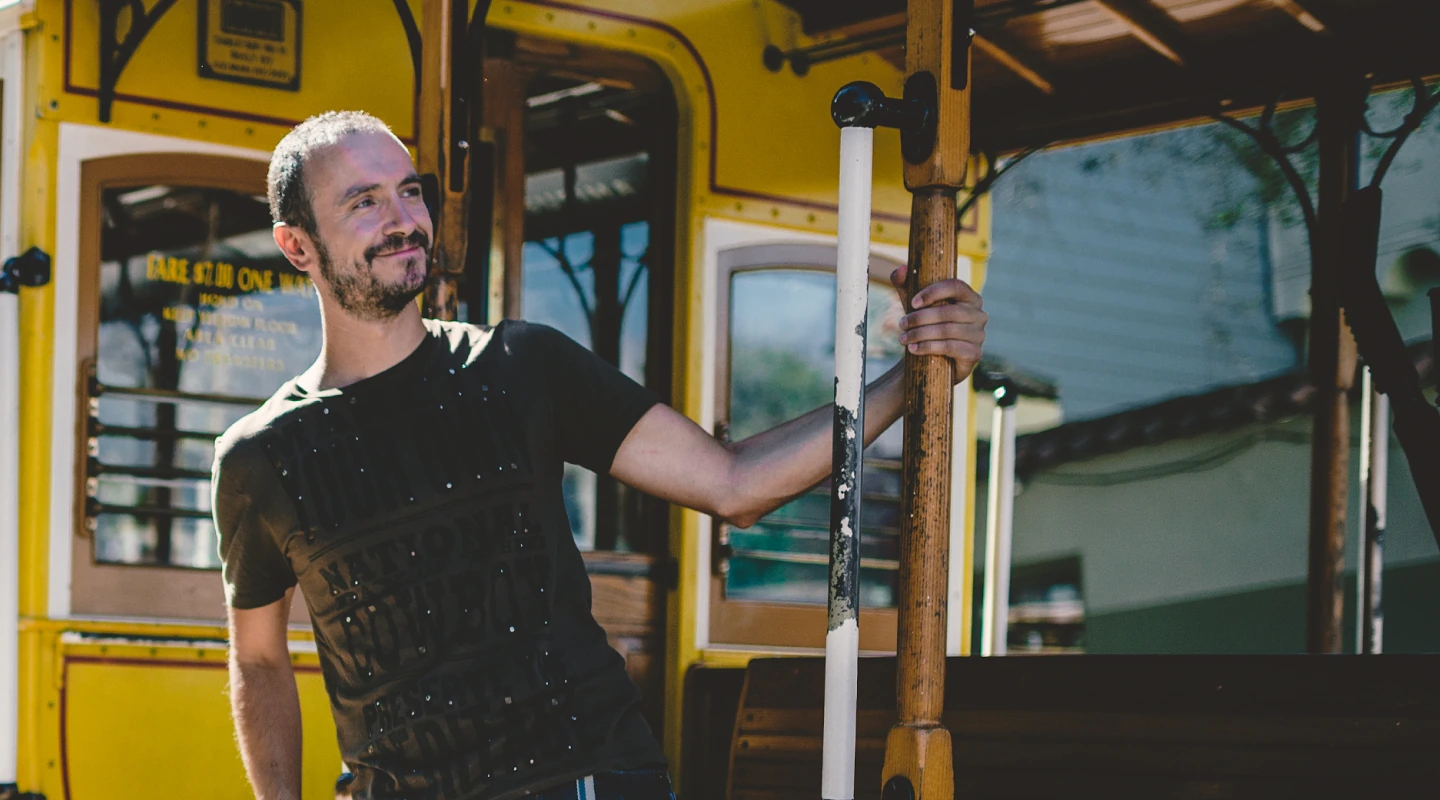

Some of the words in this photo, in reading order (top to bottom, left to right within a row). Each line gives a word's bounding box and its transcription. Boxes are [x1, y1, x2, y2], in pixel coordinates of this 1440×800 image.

[146, 254, 190, 284] FARE
[238, 267, 274, 294] ONE
[176, 348, 199, 362] NO
[319, 502, 542, 595] NATIONAL
